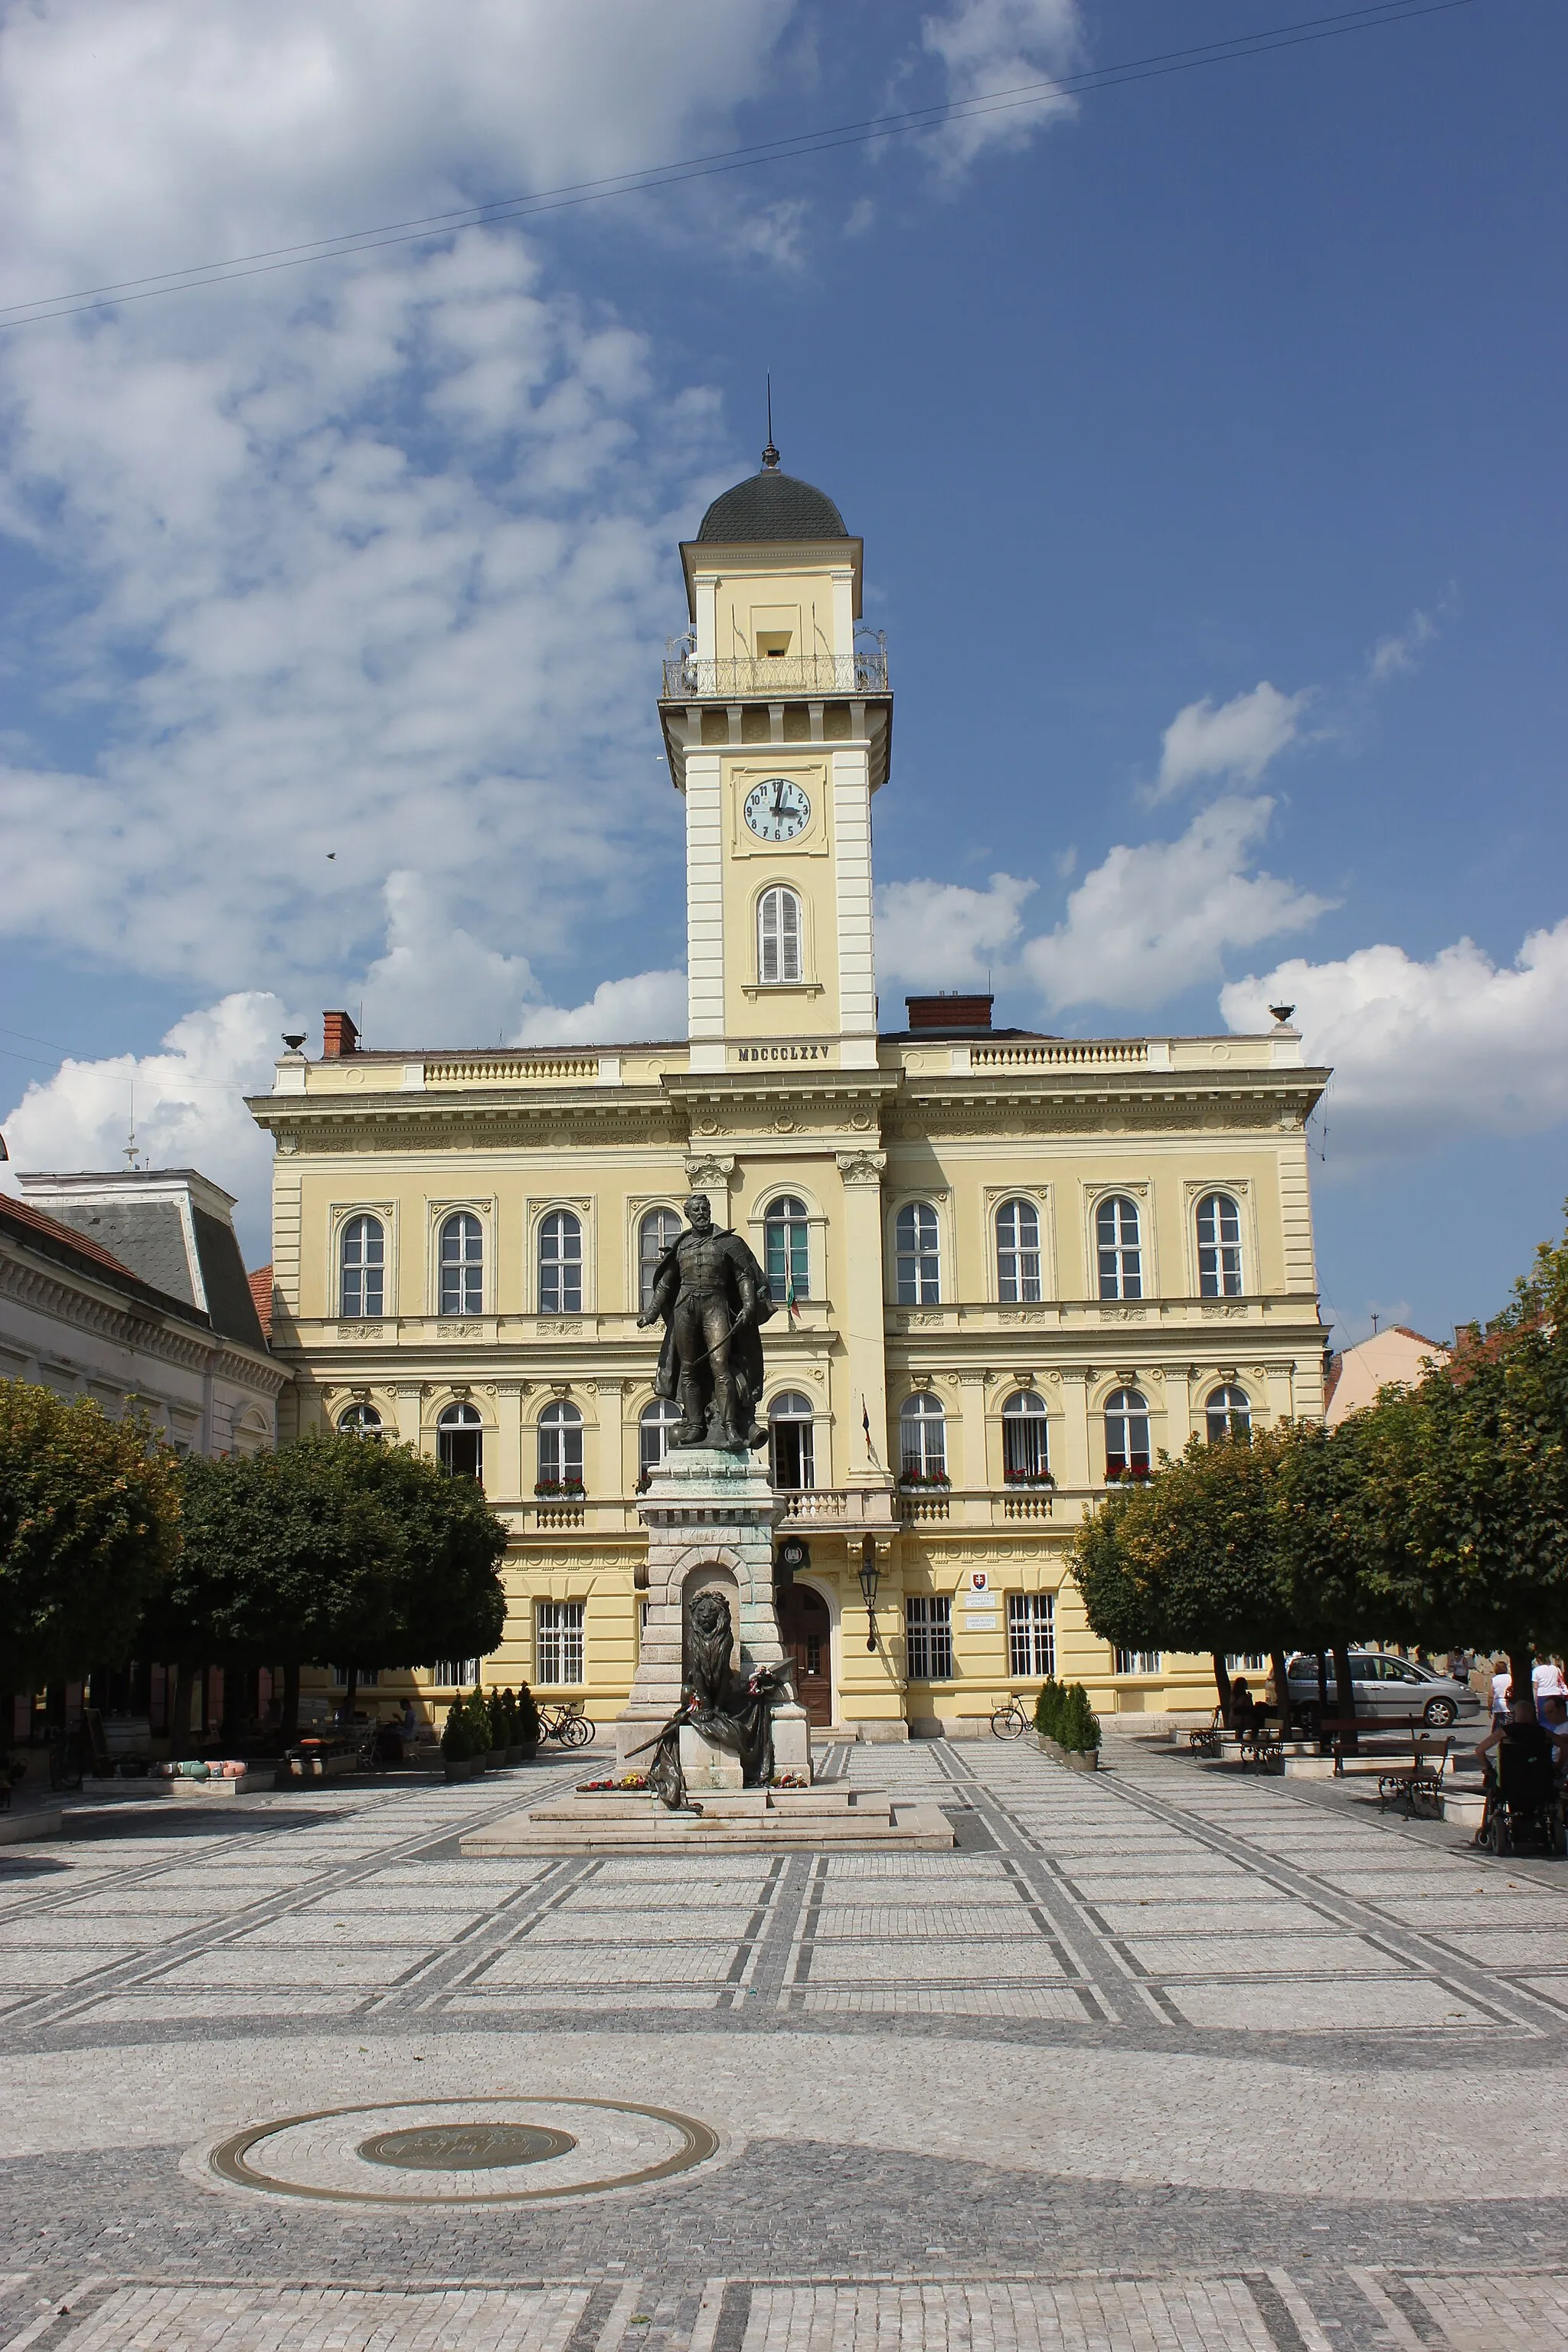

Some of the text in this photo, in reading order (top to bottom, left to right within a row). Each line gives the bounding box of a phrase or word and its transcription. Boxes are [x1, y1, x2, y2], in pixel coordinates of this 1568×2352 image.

[760, 786, 767, 796] 11
[788, 785, 792, 795] 1
[750, 795, 760, 805] 10
[798, 793, 803, 804] 2
[746, 806, 752, 817] 9
[802, 805, 808, 815] 3
[751, 819, 756, 829] 8
[797, 817, 802, 828] 4
[763, 827, 769, 837] 7
[775, 830, 780, 840] 6
[788, 826, 793, 836] 5
[738, 1046, 828, 1061] MDCCCLXXV
